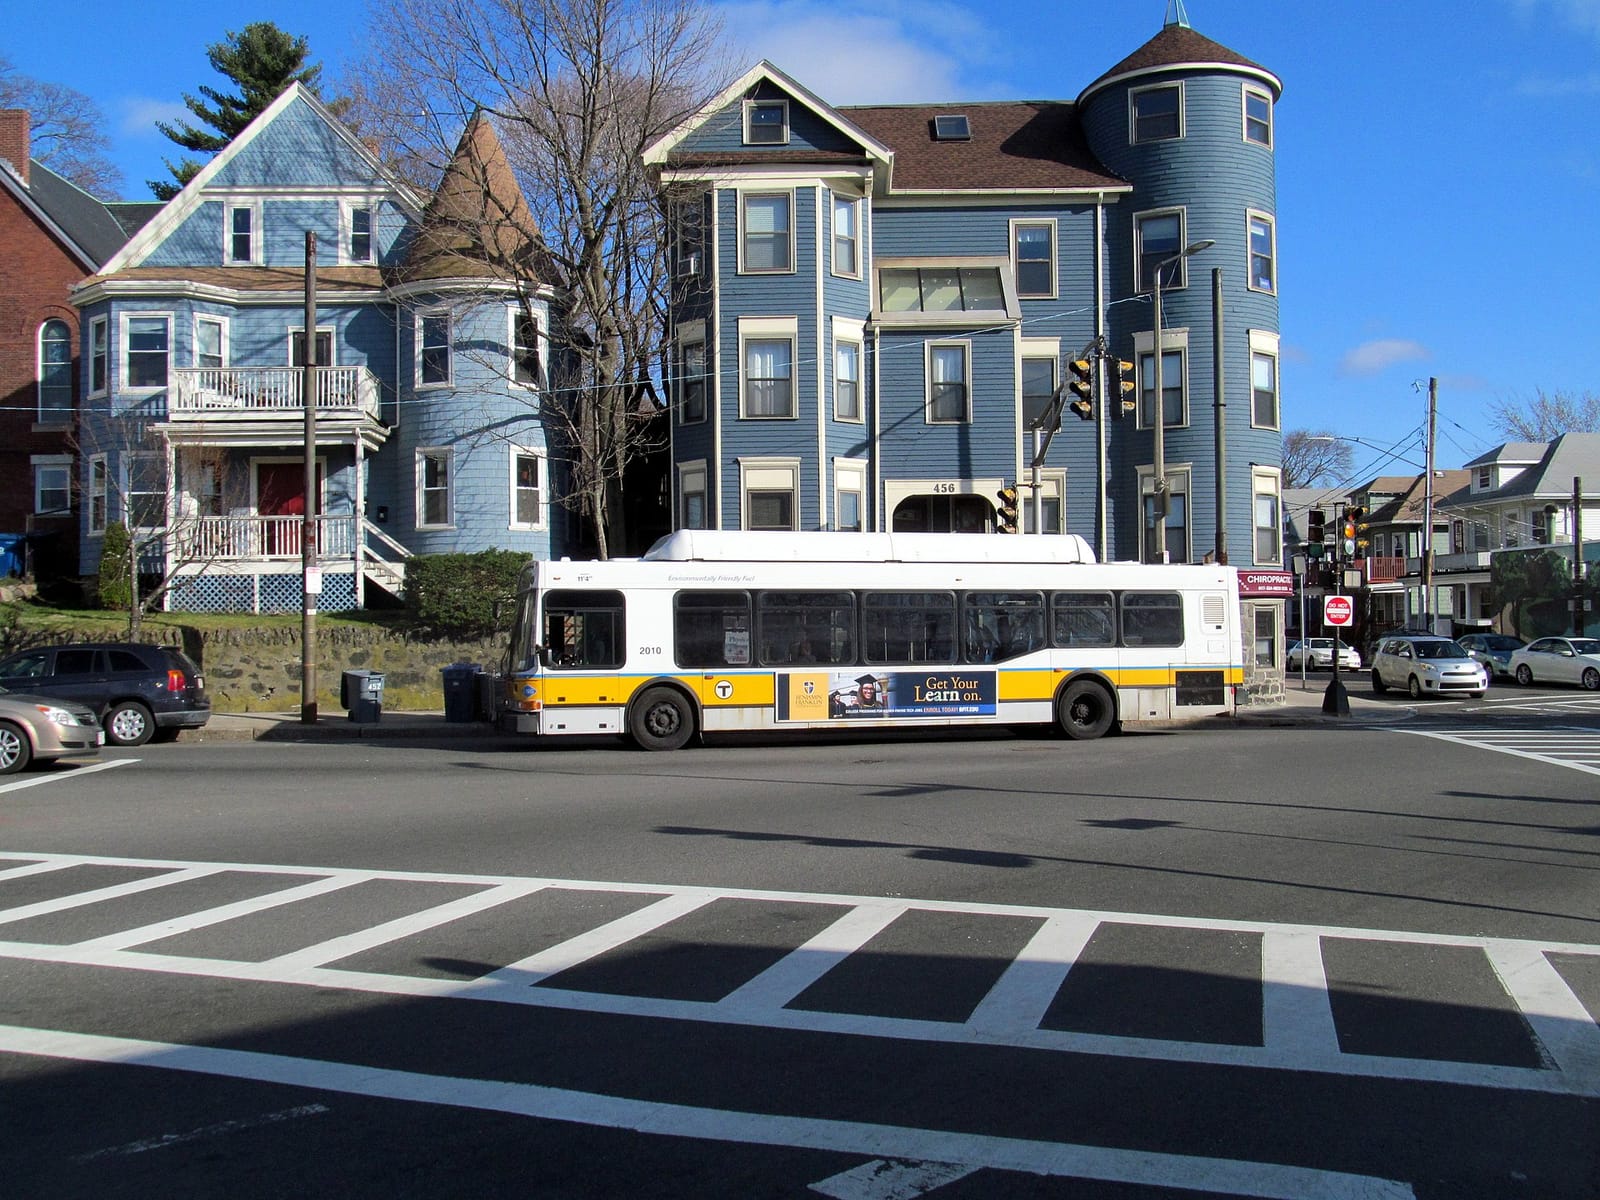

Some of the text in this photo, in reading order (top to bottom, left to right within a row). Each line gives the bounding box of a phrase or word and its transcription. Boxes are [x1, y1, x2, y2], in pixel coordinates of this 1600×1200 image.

[933, 483, 955, 493] 456
[640, 646, 662, 654] 2010
[926, 676, 978, 690] Get Your
[914, 686, 982, 702] Learn on.
